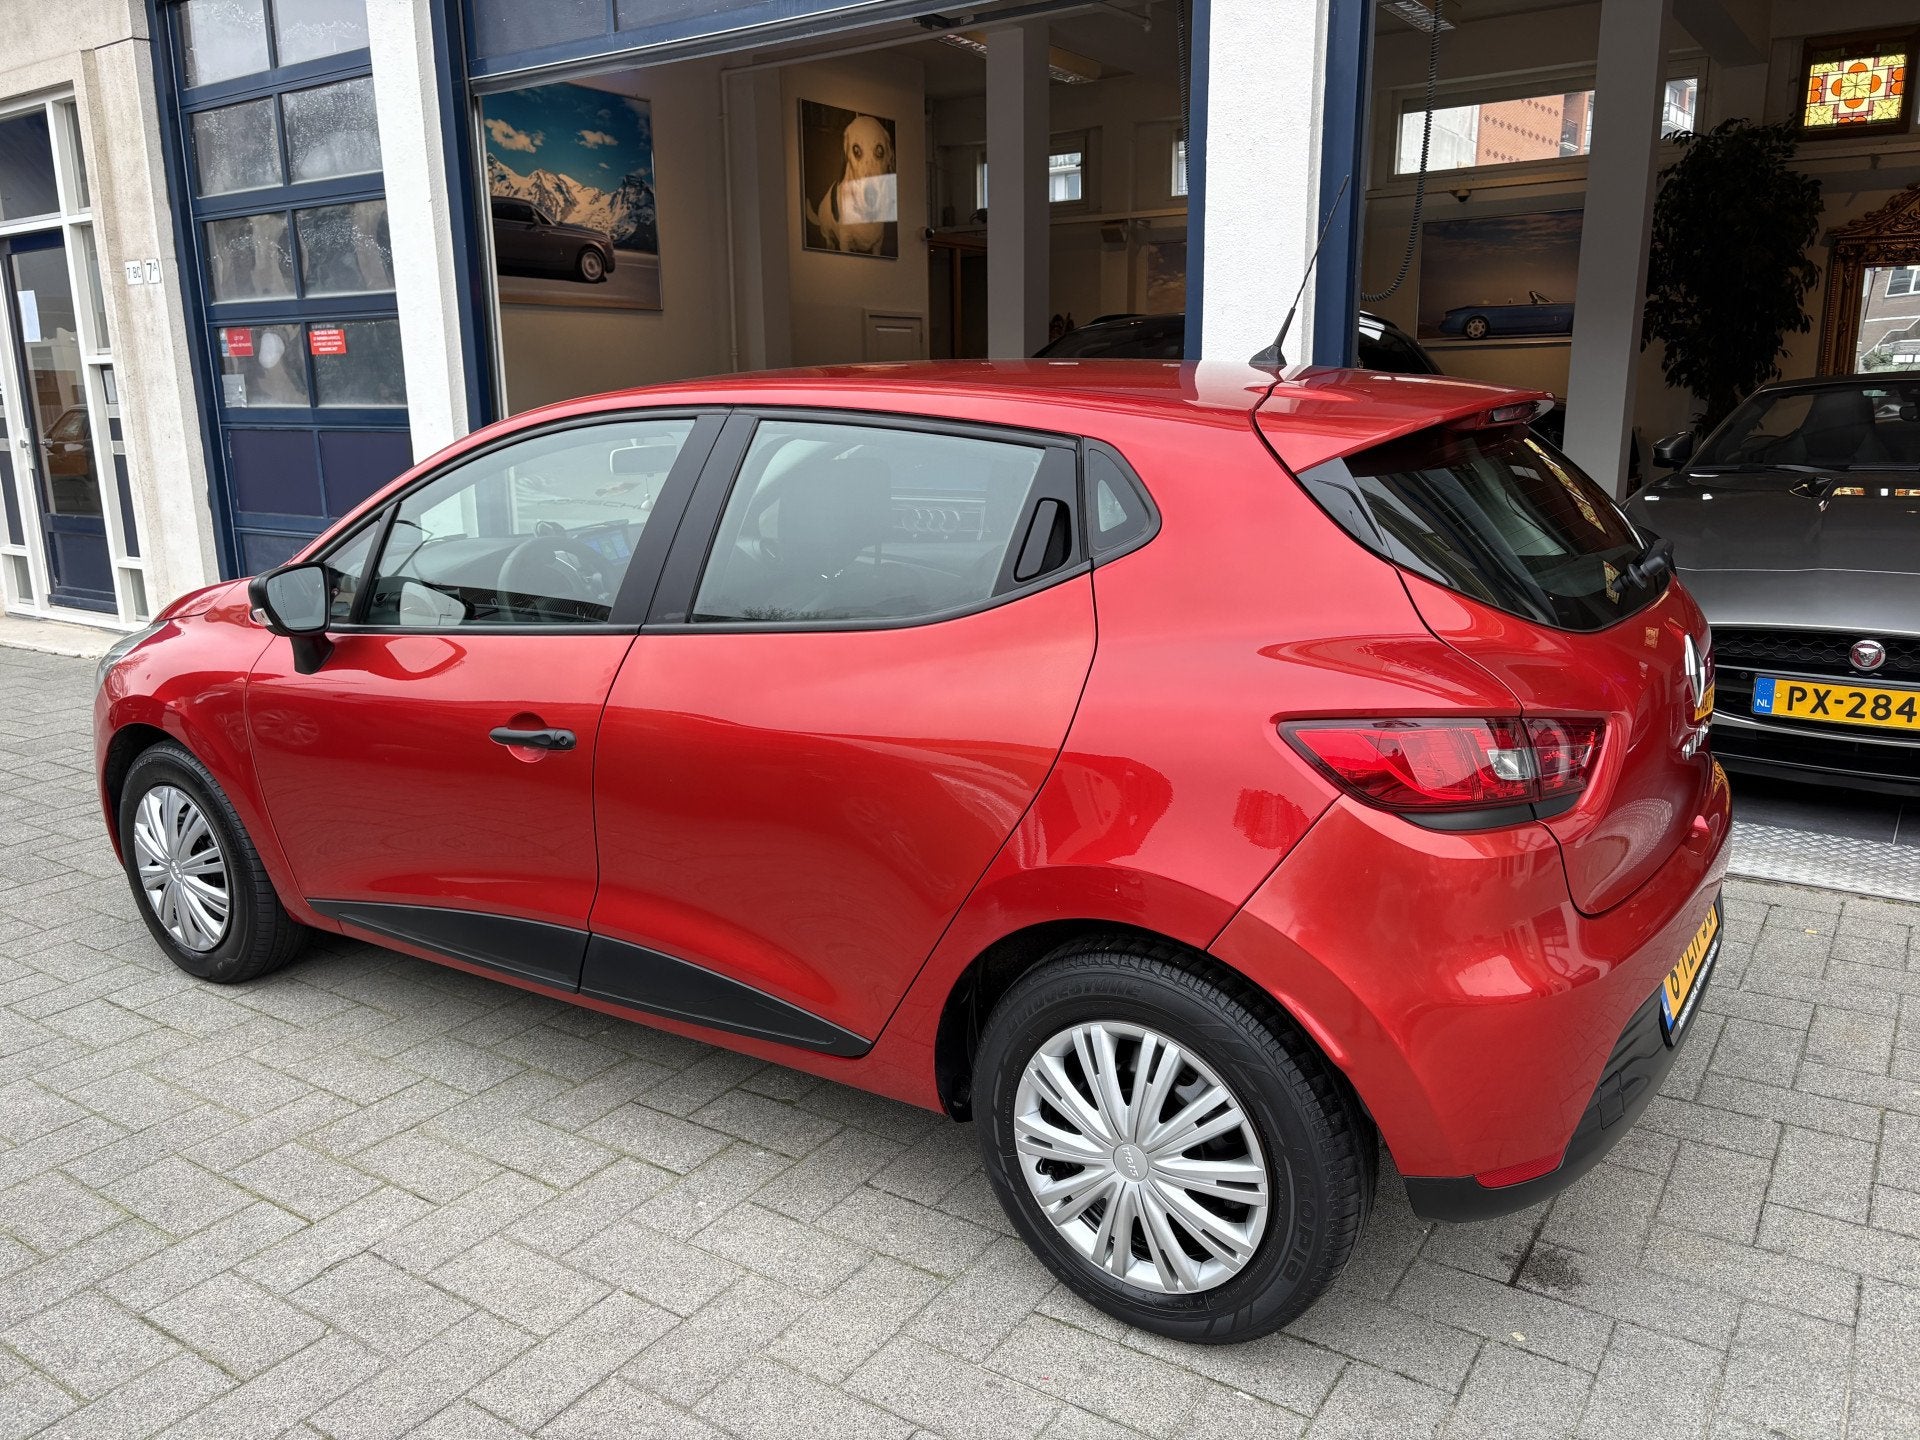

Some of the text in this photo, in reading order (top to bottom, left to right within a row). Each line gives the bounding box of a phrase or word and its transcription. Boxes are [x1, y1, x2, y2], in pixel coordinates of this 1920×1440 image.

[537, 497, 642, 510] PORSCH
[1756, 698, 1771, 708] NL
[1786, 685, 1918, 723] PX-284
